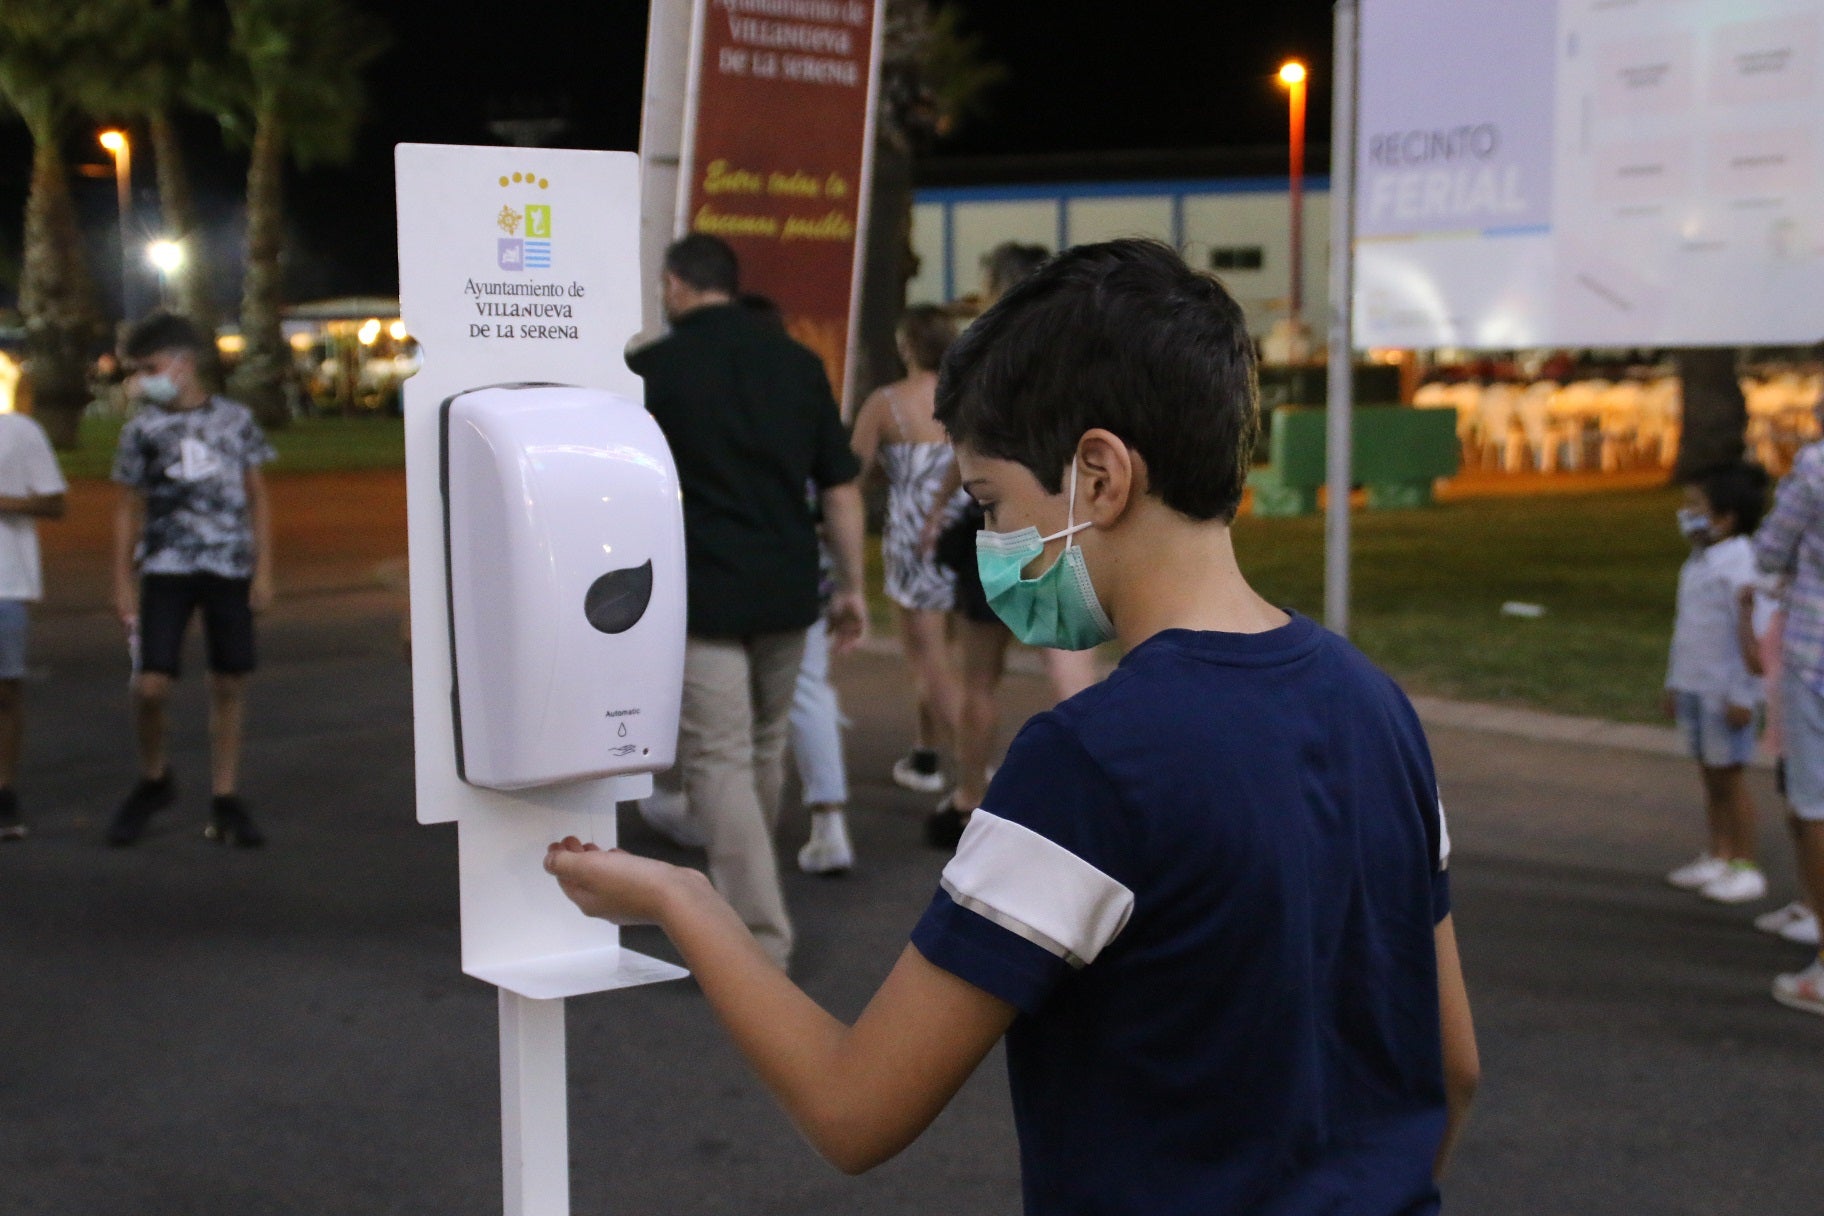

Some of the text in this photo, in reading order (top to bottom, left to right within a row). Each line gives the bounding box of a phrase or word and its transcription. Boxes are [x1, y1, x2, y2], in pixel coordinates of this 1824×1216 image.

[1369, 124, 1497, 165] RECINTO
[1370, 163, 1527, 223] FERIAL
[464, 278, 585, 299] Ayuntamiento de
[605, 708, 641, 717] Automatic
